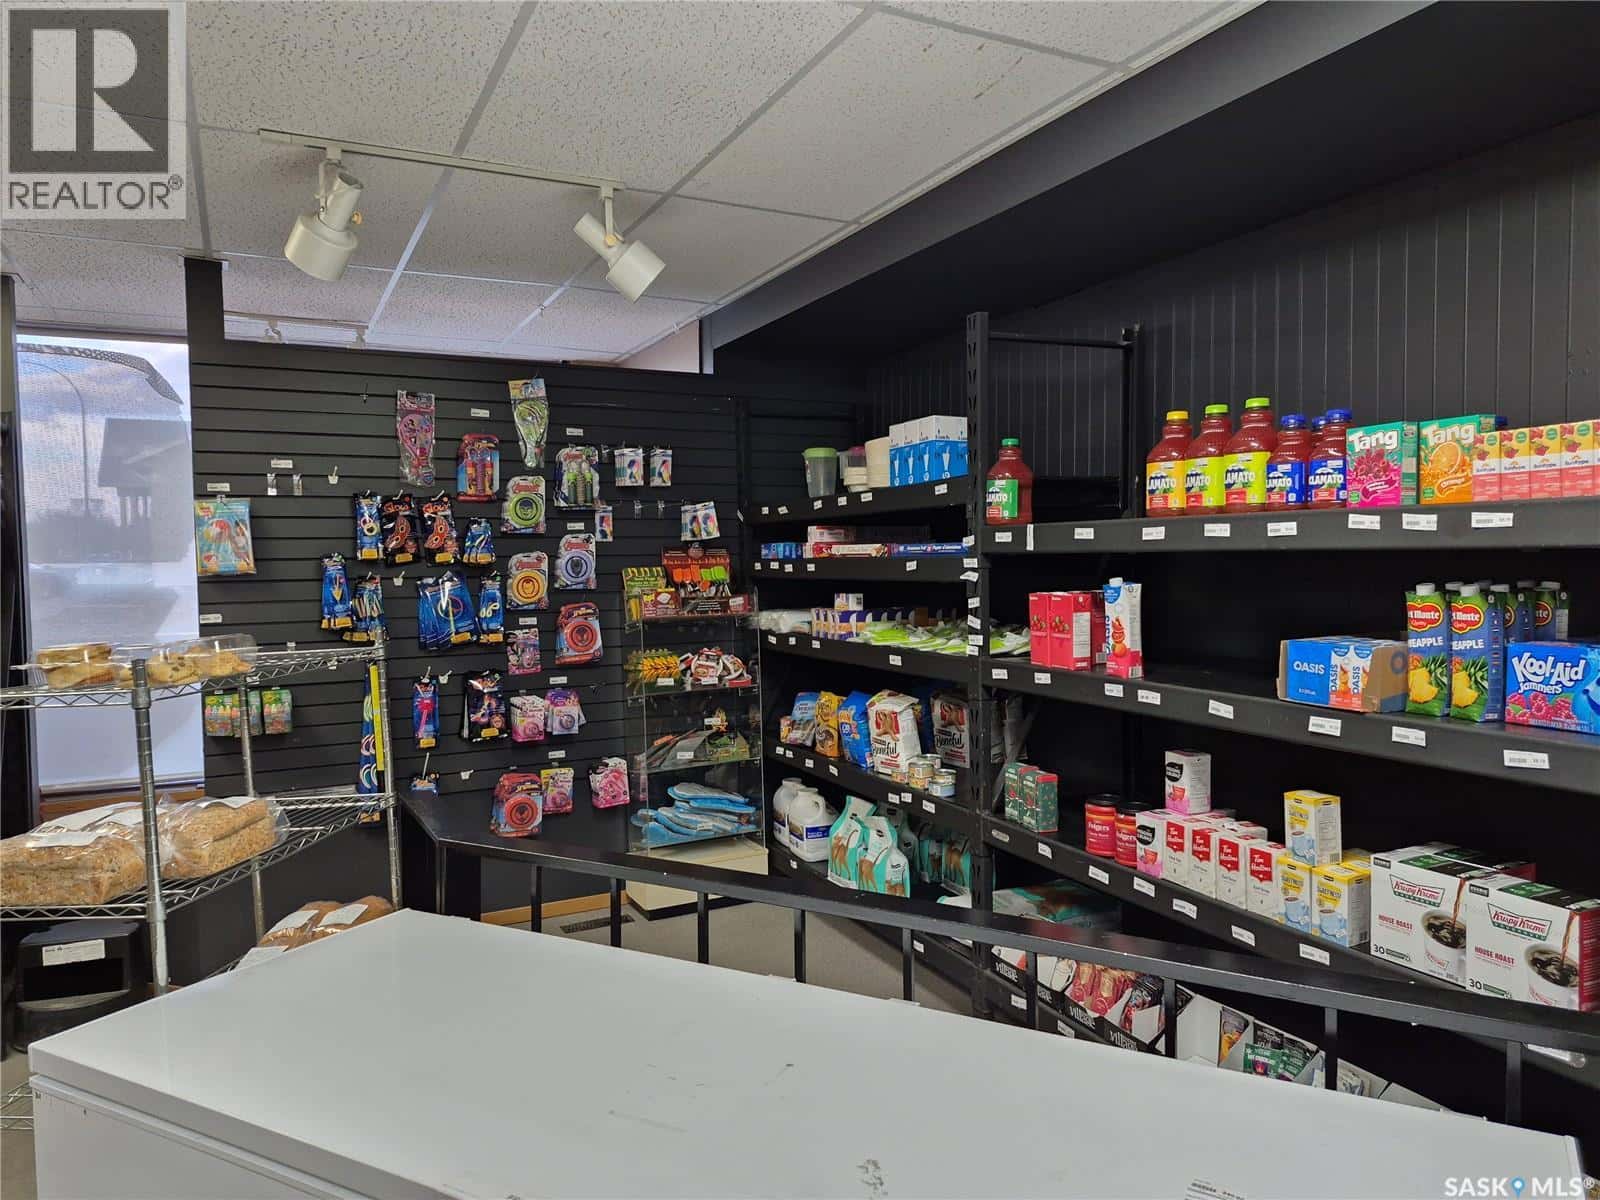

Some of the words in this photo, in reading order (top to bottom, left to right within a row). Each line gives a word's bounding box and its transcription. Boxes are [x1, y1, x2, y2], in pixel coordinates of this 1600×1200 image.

[1349, 430, 1398, 452] Tang
[1422, 424, 1475, 445] Tang
[1308, 474, 1344, 486] CLAMATO
[1293, 661, 1325, 674] OASIS
[1512, 652, 1586, 687] Kool-Aid
[1330, 663, 1338, 692] OASIS
[1352, 665, 1361, 695] OASIS
[1222, 845, 1232, 853] Tim
[1253, 855, 1264, 863] Tim
[1493, 911, 1519, 927] Krispy
[1520, 918, 1546, 934] Kreme
[1374, 944, 1385, 955] 30
[1475, 946, 1493, 958] HOUSE
[1495, 953, 1515, 965] ROAST
[1469, 978, 1482, 990] 30
